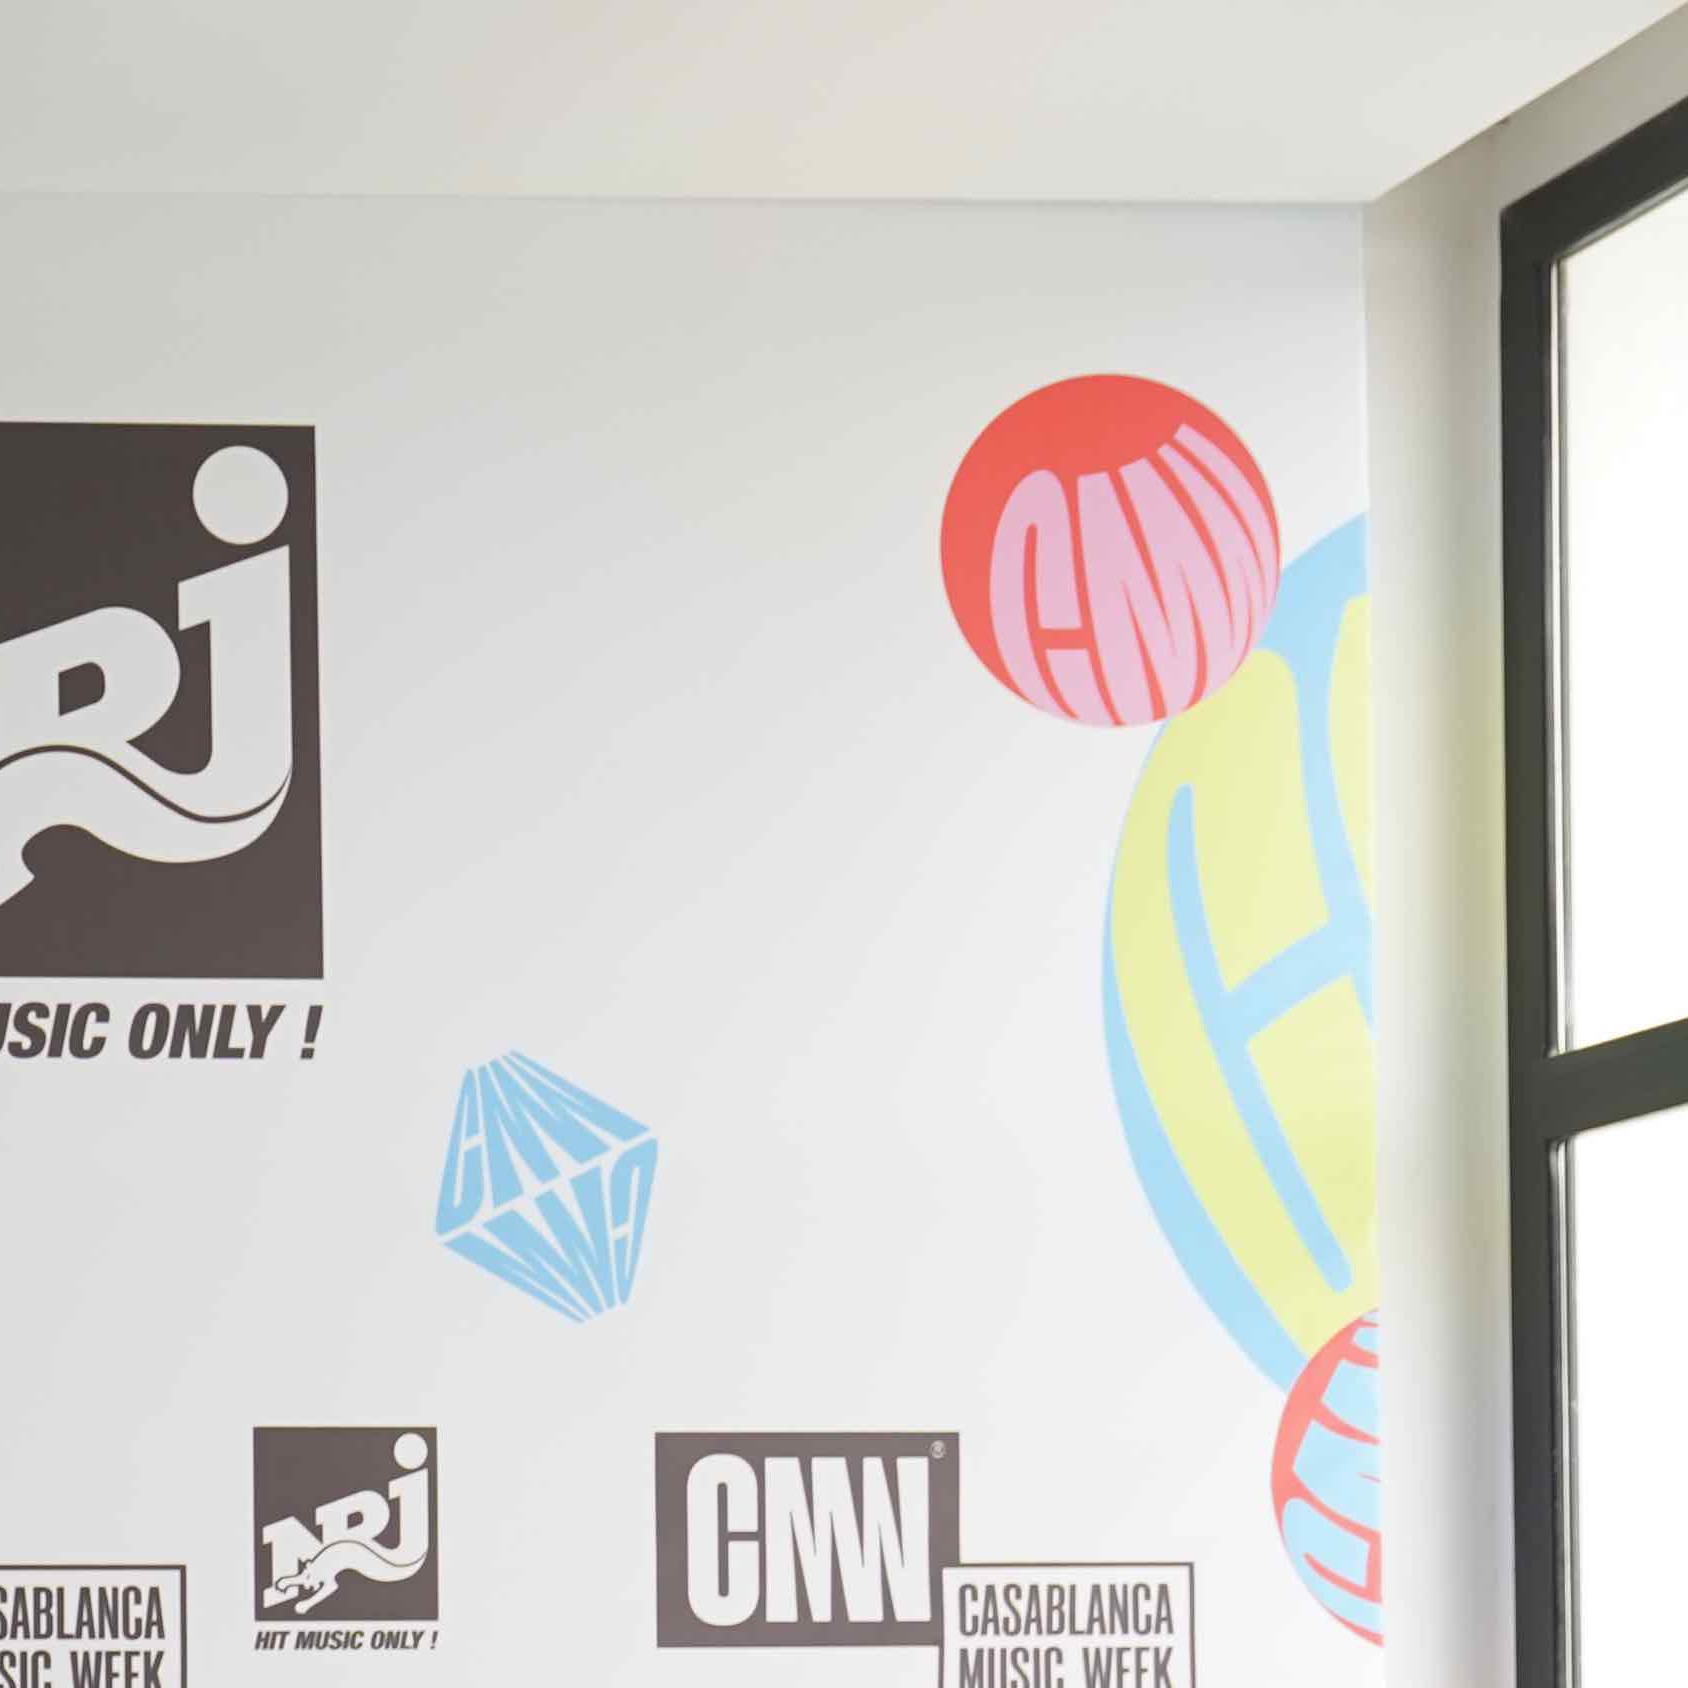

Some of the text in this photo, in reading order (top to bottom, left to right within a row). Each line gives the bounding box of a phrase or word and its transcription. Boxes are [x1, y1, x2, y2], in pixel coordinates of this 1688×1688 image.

[129, 1003, 285, 1059] ONLY
[959, 1583, 1174, 1636] CASABLANCA
[254, 1630, 290, 1650] HIT
[294, 1630, 364, 1650] MUSIC
[371, 1630, 424, 1650] ONLY
